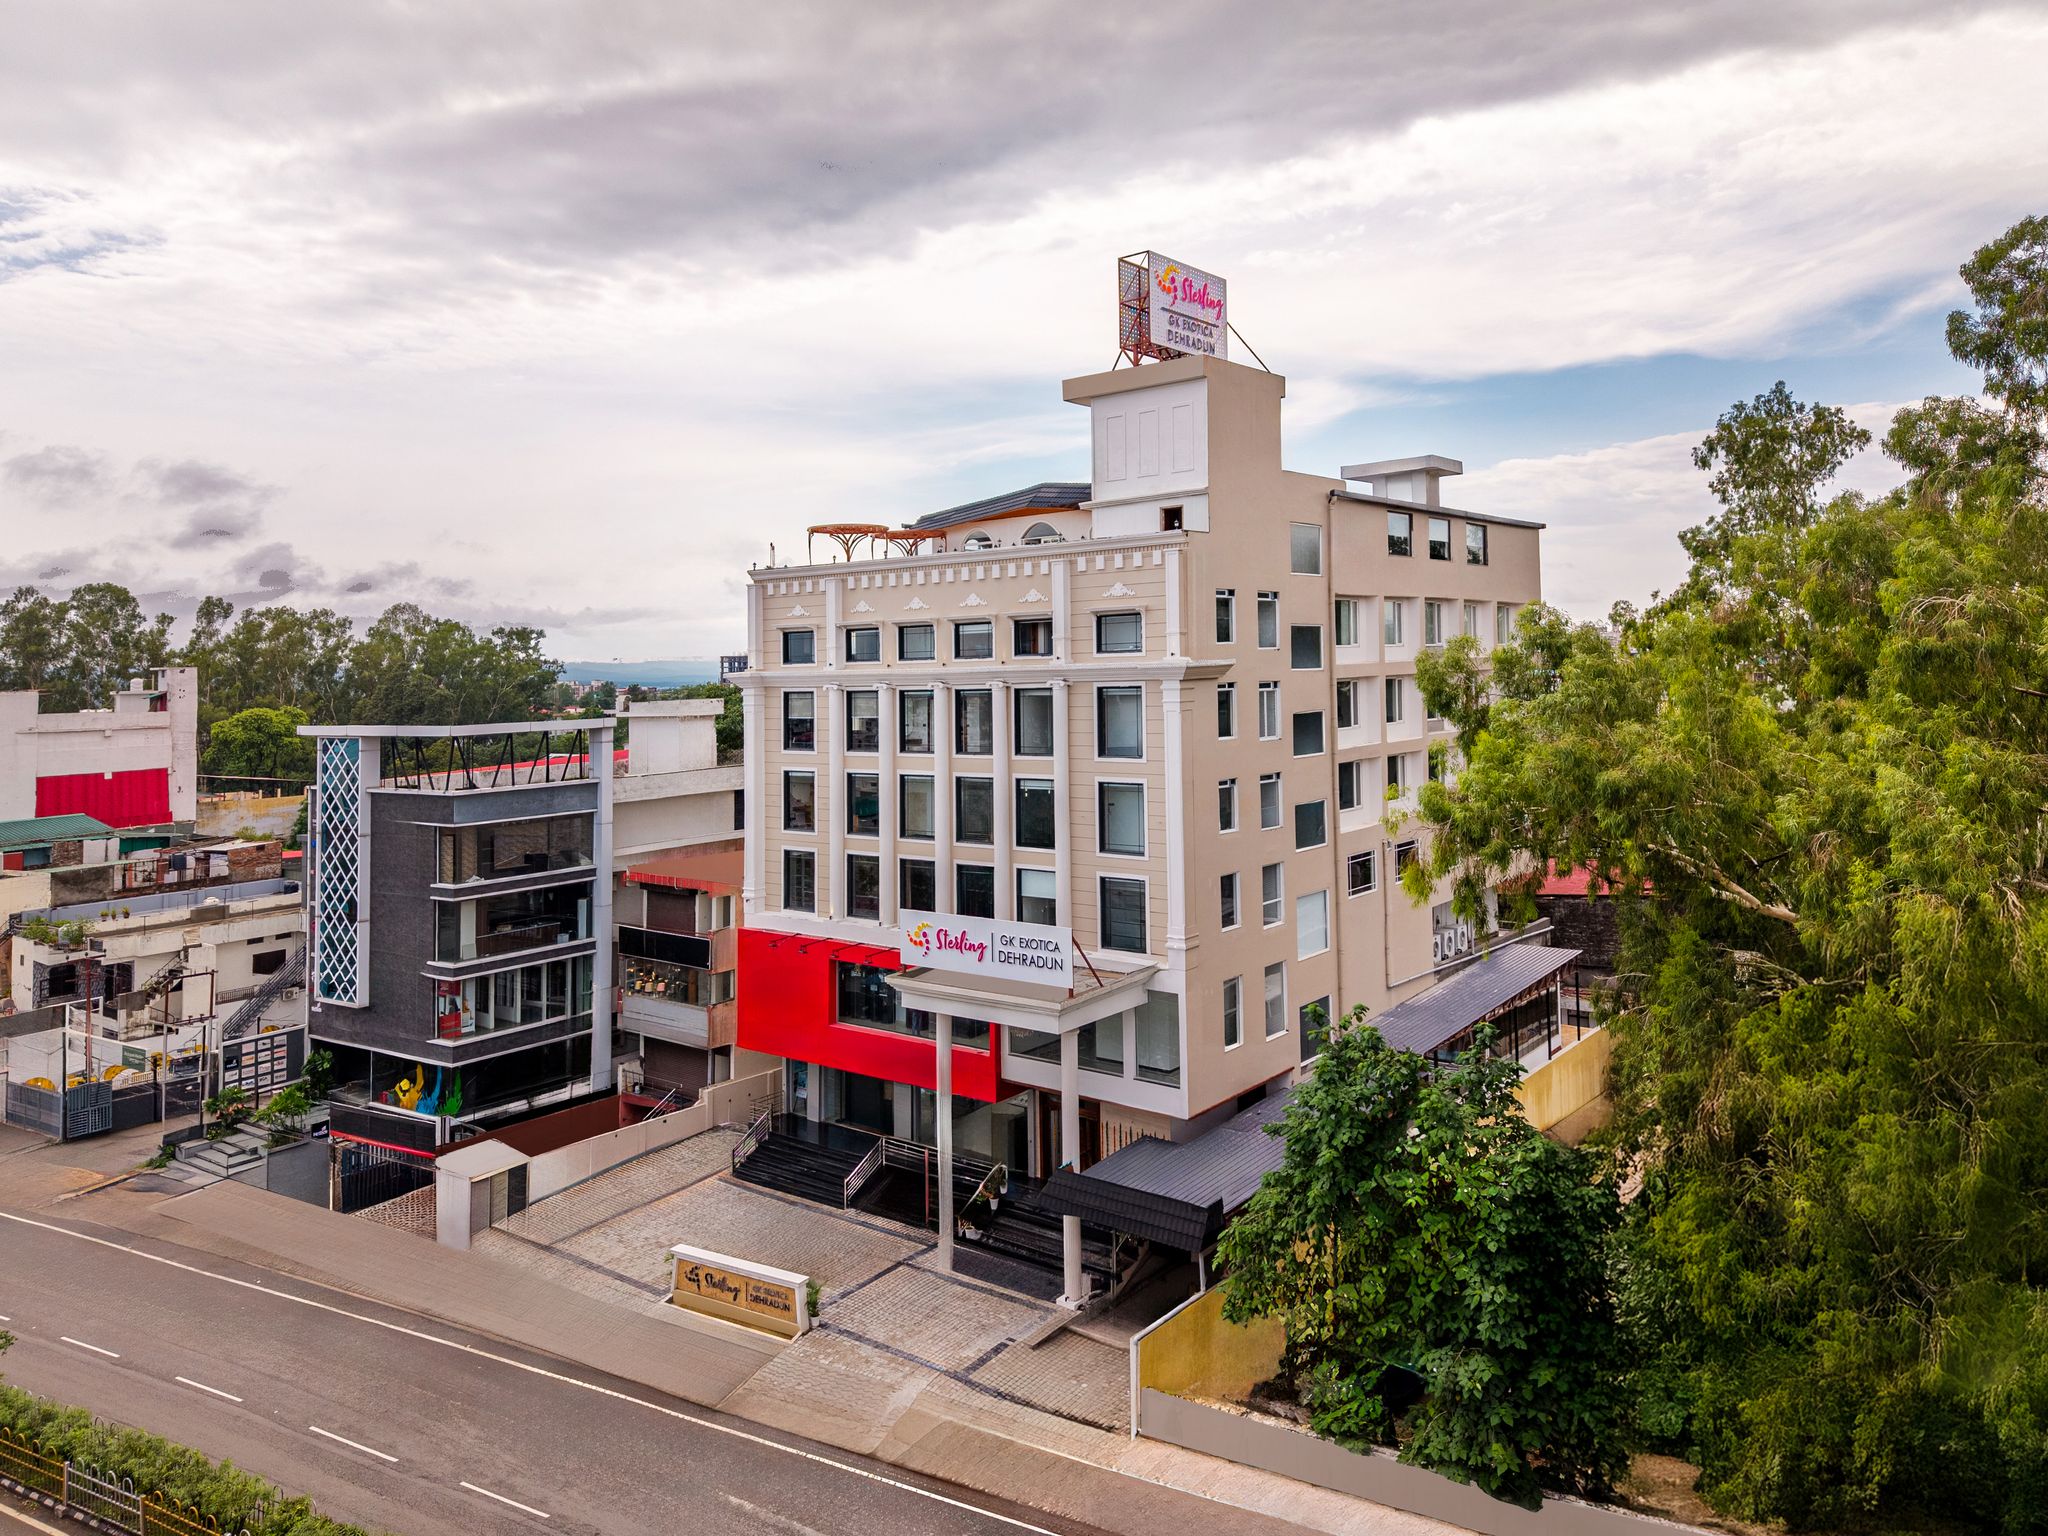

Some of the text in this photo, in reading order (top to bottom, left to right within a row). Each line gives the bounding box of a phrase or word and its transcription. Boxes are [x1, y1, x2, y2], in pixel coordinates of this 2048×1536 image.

[1182, 277, 1224, 320] Sterling
[1168, 315, 1213, 338] GK EXOTICA
[1167, 329, 1215, 355] DEHRADUN
[936, 928, 987, 962] Sterling
[1000, 935, 1060, 953] GK EXOTICA
[999, 951, 1063, 971] DEHRADUN
